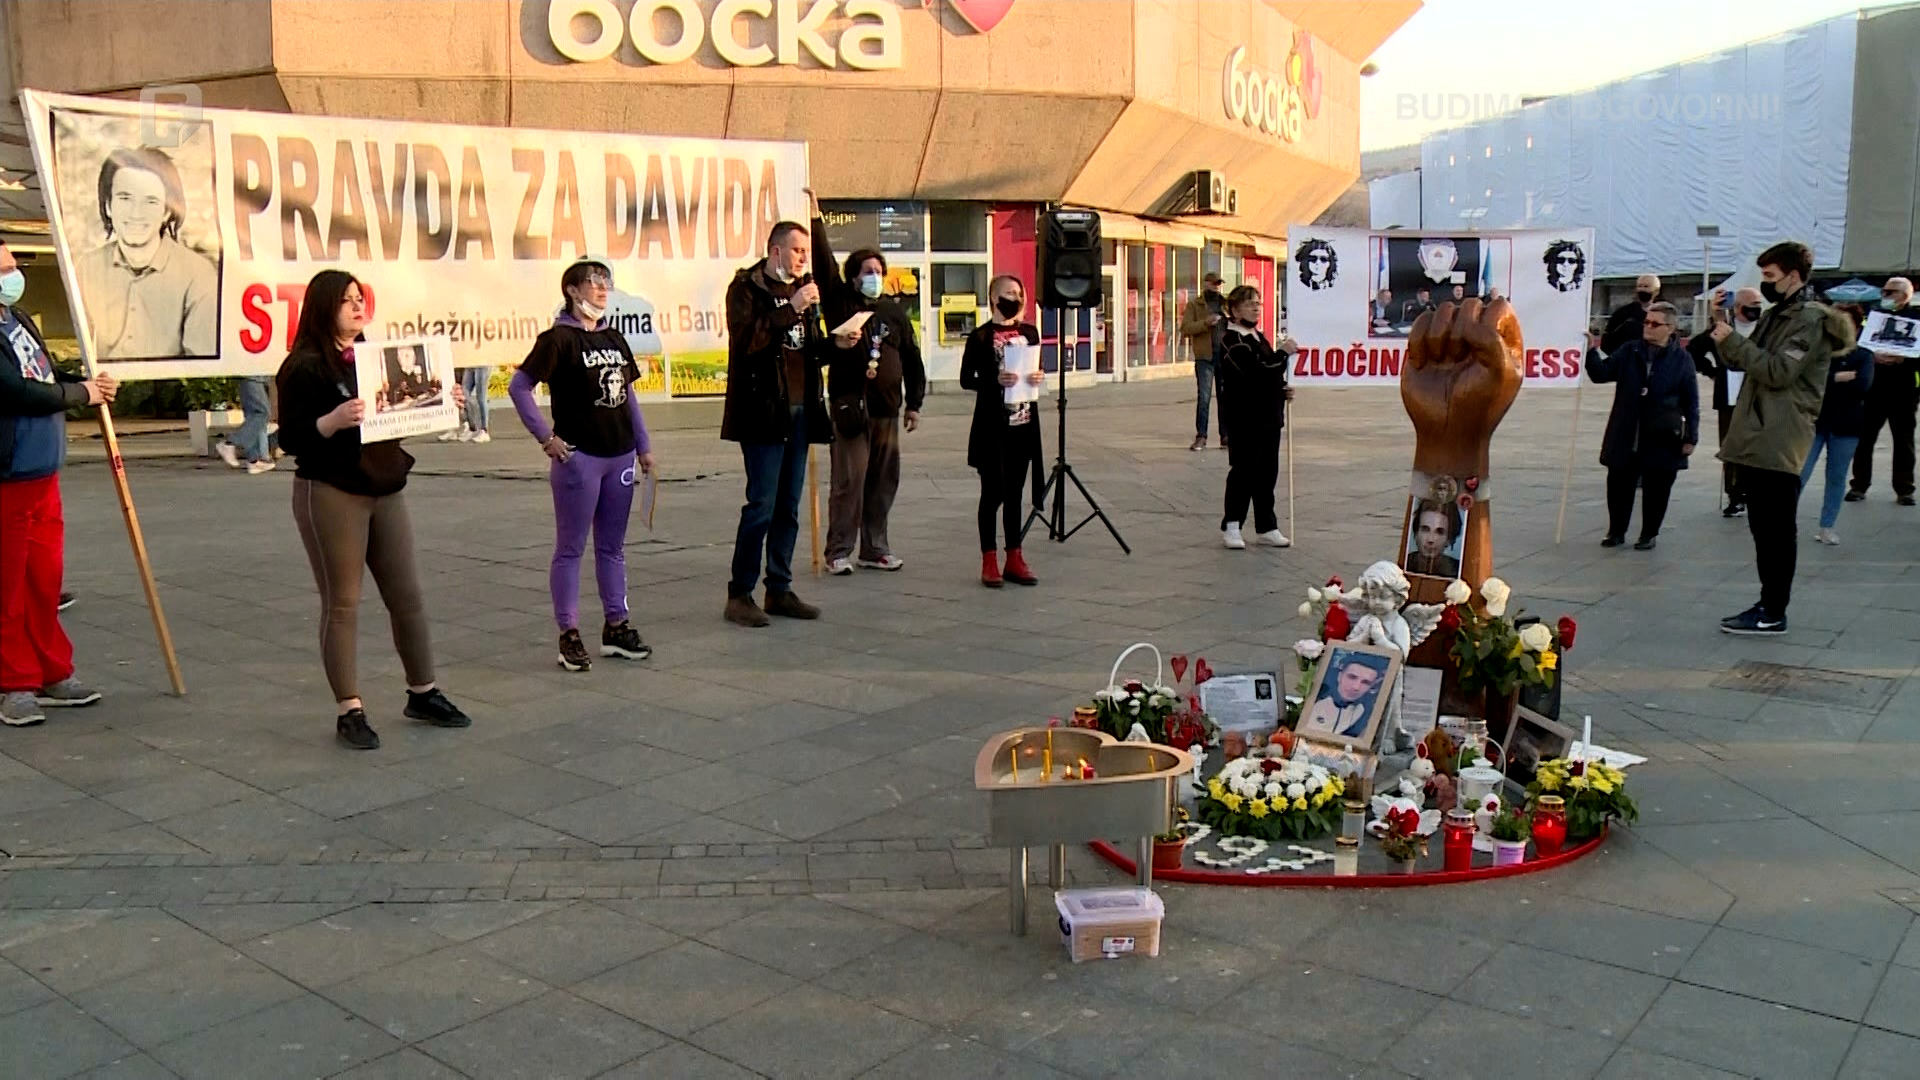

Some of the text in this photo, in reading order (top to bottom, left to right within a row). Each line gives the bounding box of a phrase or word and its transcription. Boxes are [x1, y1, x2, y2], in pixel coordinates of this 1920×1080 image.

[230, 133, 781, 261] PRAVDA ZA DAVIDA
[239, 282, 376, 354] ST
[386, 310, 539, 350] nekažnjenim
[660, 312, 672, 334] u
[679, 304, 729, 338] Banj
[1294, 343, 1411, 377] ZLOČIN
